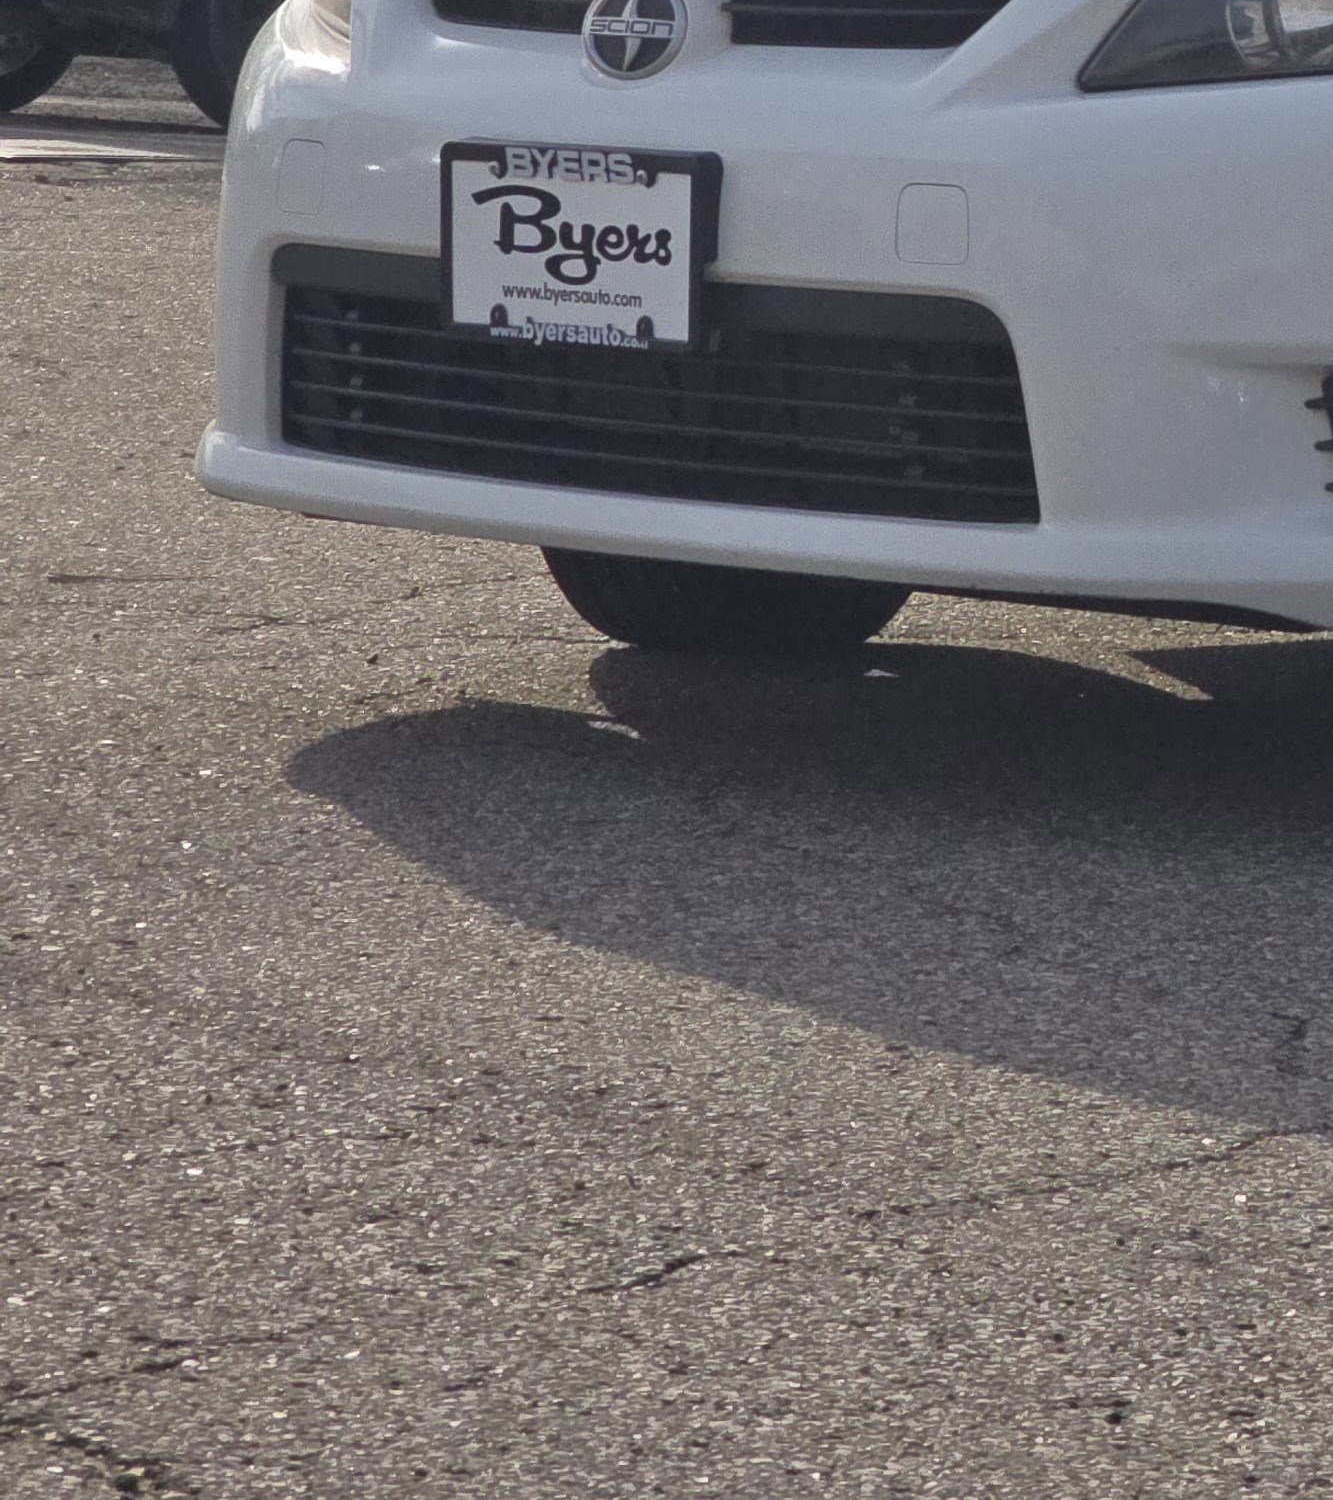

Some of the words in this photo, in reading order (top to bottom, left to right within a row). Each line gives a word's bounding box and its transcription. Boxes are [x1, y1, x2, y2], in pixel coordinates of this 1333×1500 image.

[505, 147, 635, 184] BYERS
[471, 184, 672, 286] Byers
[502, 282, 642, 309] www.byersauto.com
